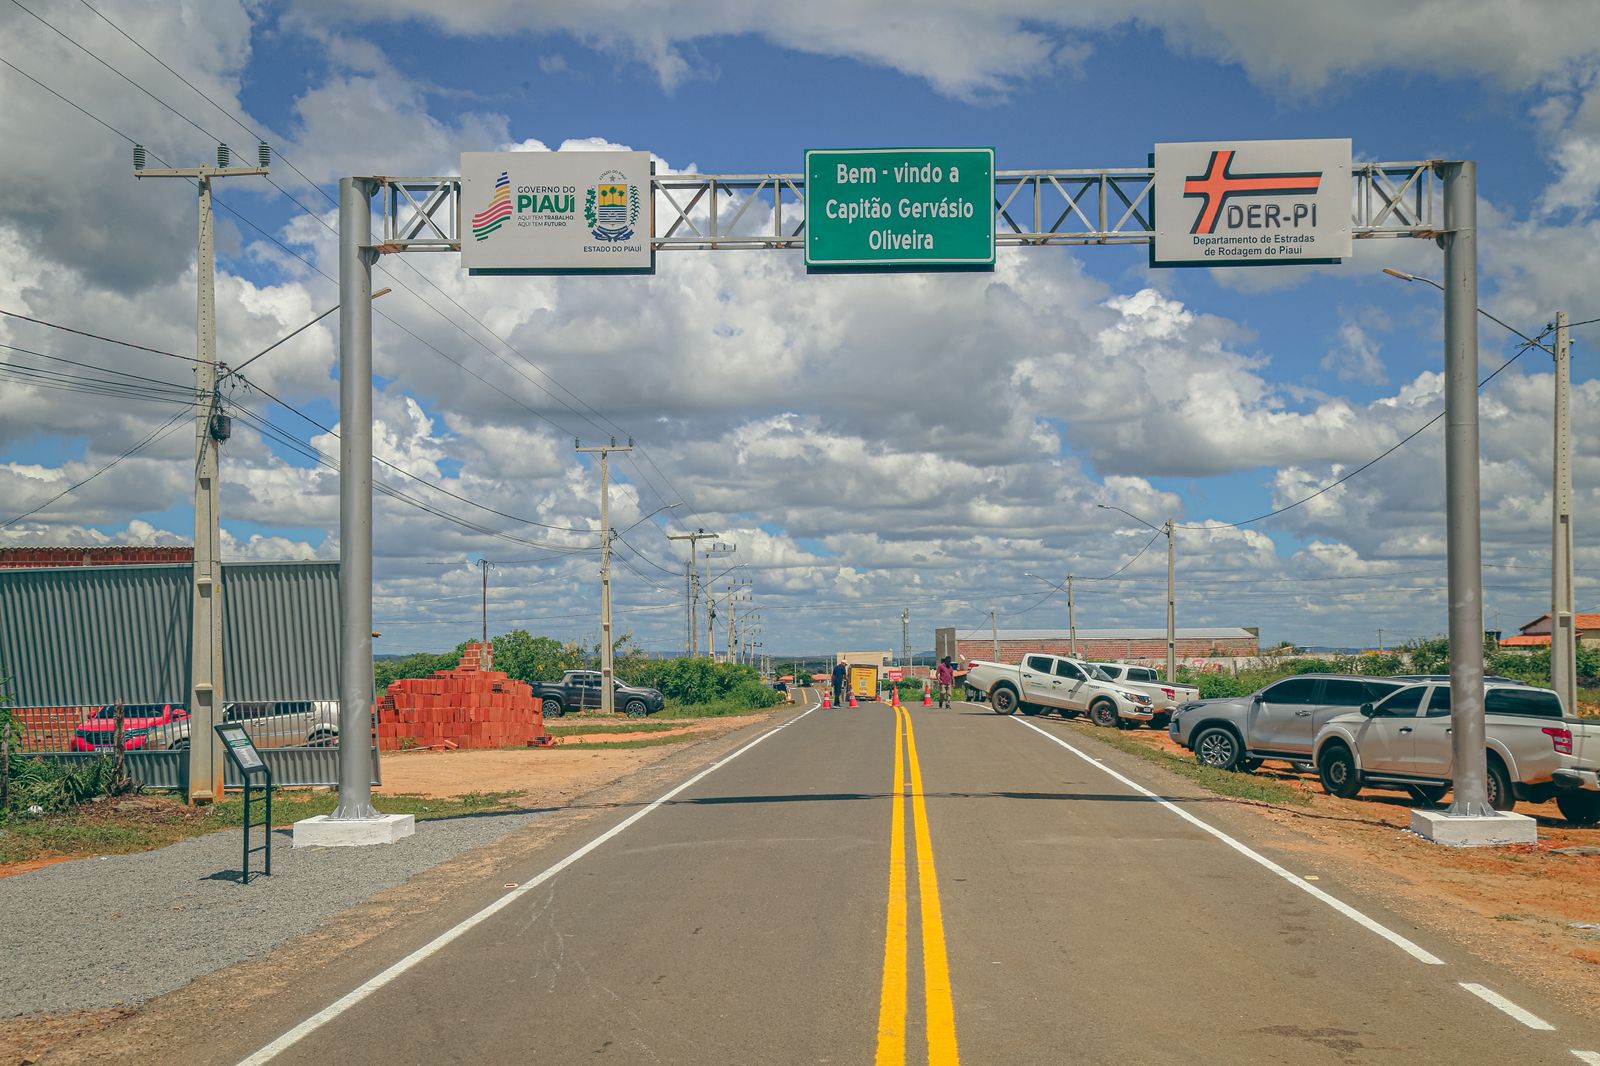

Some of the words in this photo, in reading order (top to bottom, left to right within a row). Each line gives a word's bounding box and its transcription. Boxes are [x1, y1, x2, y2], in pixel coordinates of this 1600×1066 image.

[837, 163, 876, 184] Bem
[894, 162, 943, 183] vindo
[949, 166, 959, 183] a
[517, 185, 560, 193] GOVERNO
[562, 185, 576, 193] DO
[517, 194, 575, 213] PIAUÍ
[825, 197, 892, 224] Capitão
[898, 197, 974, 218] Gervásio
[1227, 203, 1317, 229] DER-PI
[869, 229, 934, 250] Oliveira
[1193, 235, 1257, 246] Departamento
[1260, 235, 1272, 243] de
[1274, 234, 1315, 243] Estradas
[1204, 247, 1216, 256] de
[1218, 247, 1262, 257] Rodagem
[1264, 246, 1276, 255] do
